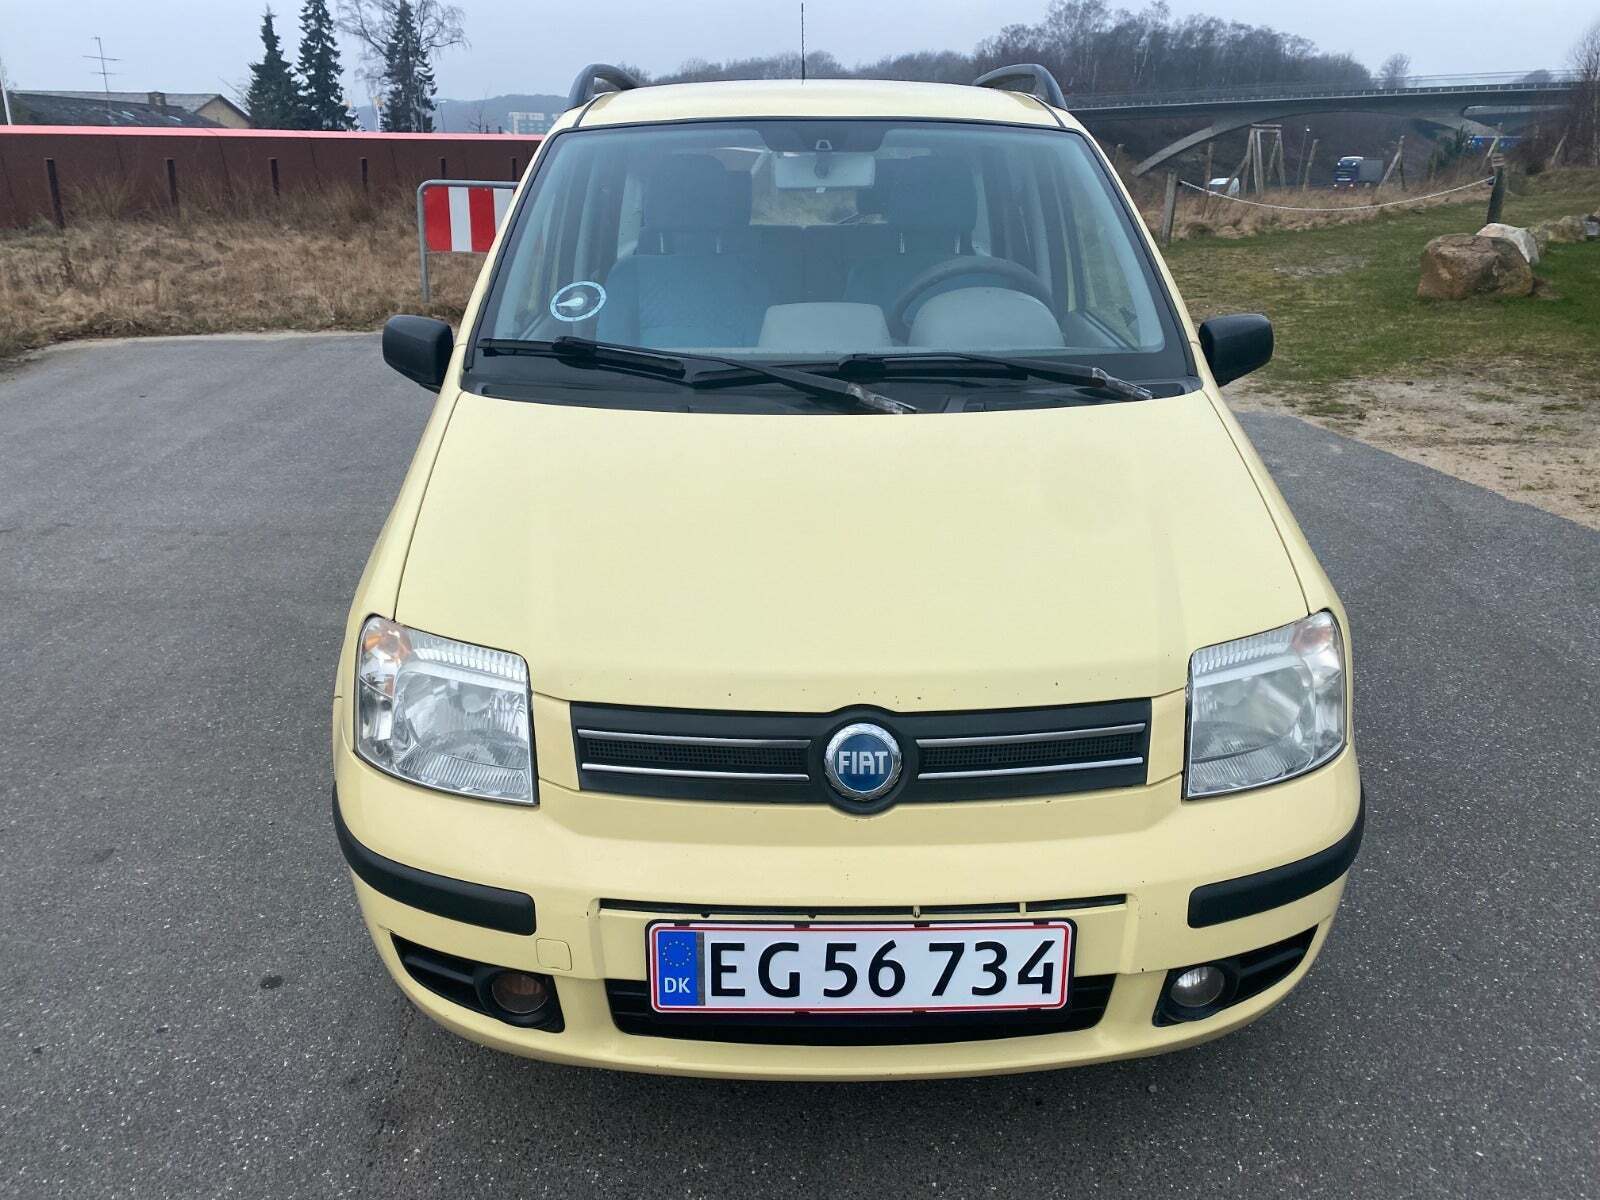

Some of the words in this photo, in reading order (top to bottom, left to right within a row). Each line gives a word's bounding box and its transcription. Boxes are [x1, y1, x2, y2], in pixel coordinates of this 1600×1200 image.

[838, 751, 888, 775] FIAT
[710, 942, 800, 998] EG
[823, 940, 906, 998] 56
[928, 940, 1056, 997] 734
[663, 977, 690, 994] DK
